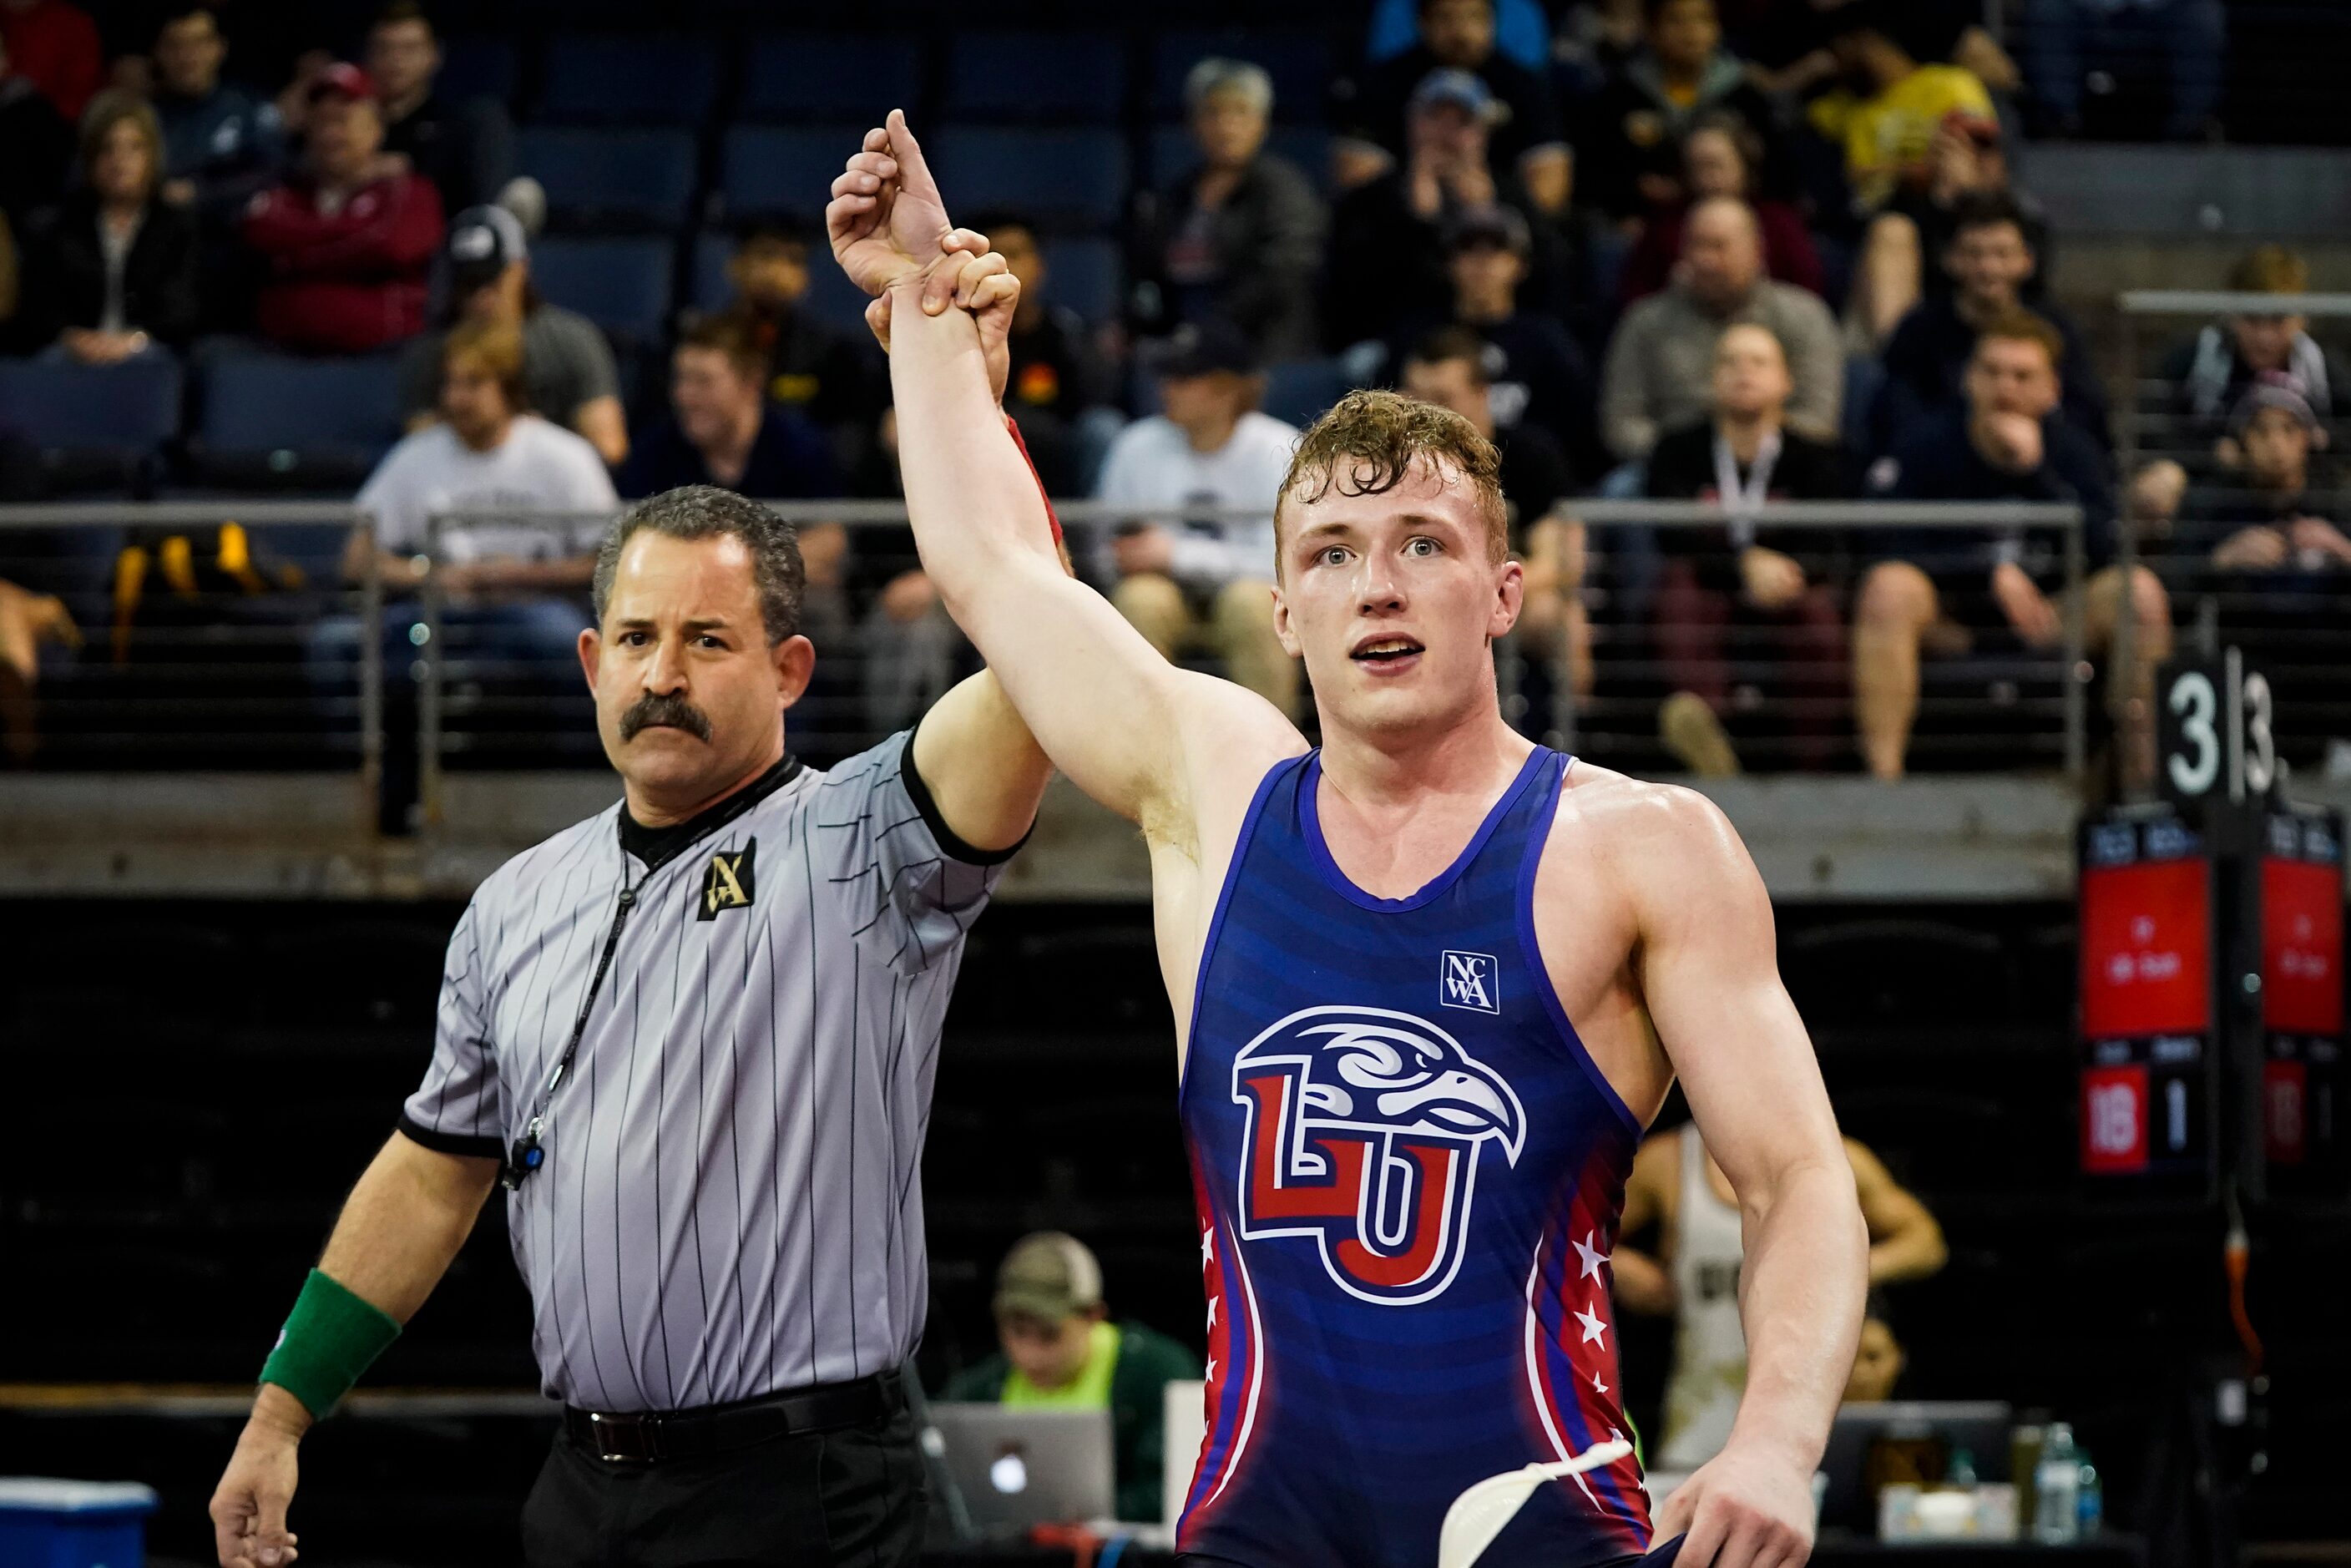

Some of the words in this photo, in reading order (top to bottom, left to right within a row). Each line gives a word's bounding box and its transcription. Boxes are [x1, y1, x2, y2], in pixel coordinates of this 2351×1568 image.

[2167, 671, 2219, 795] 3
[2243, 671, 2274, 793] 3
[2166, 1078, 2187, 1153] 1
[1241, 1071, 1465, 1291] LU
